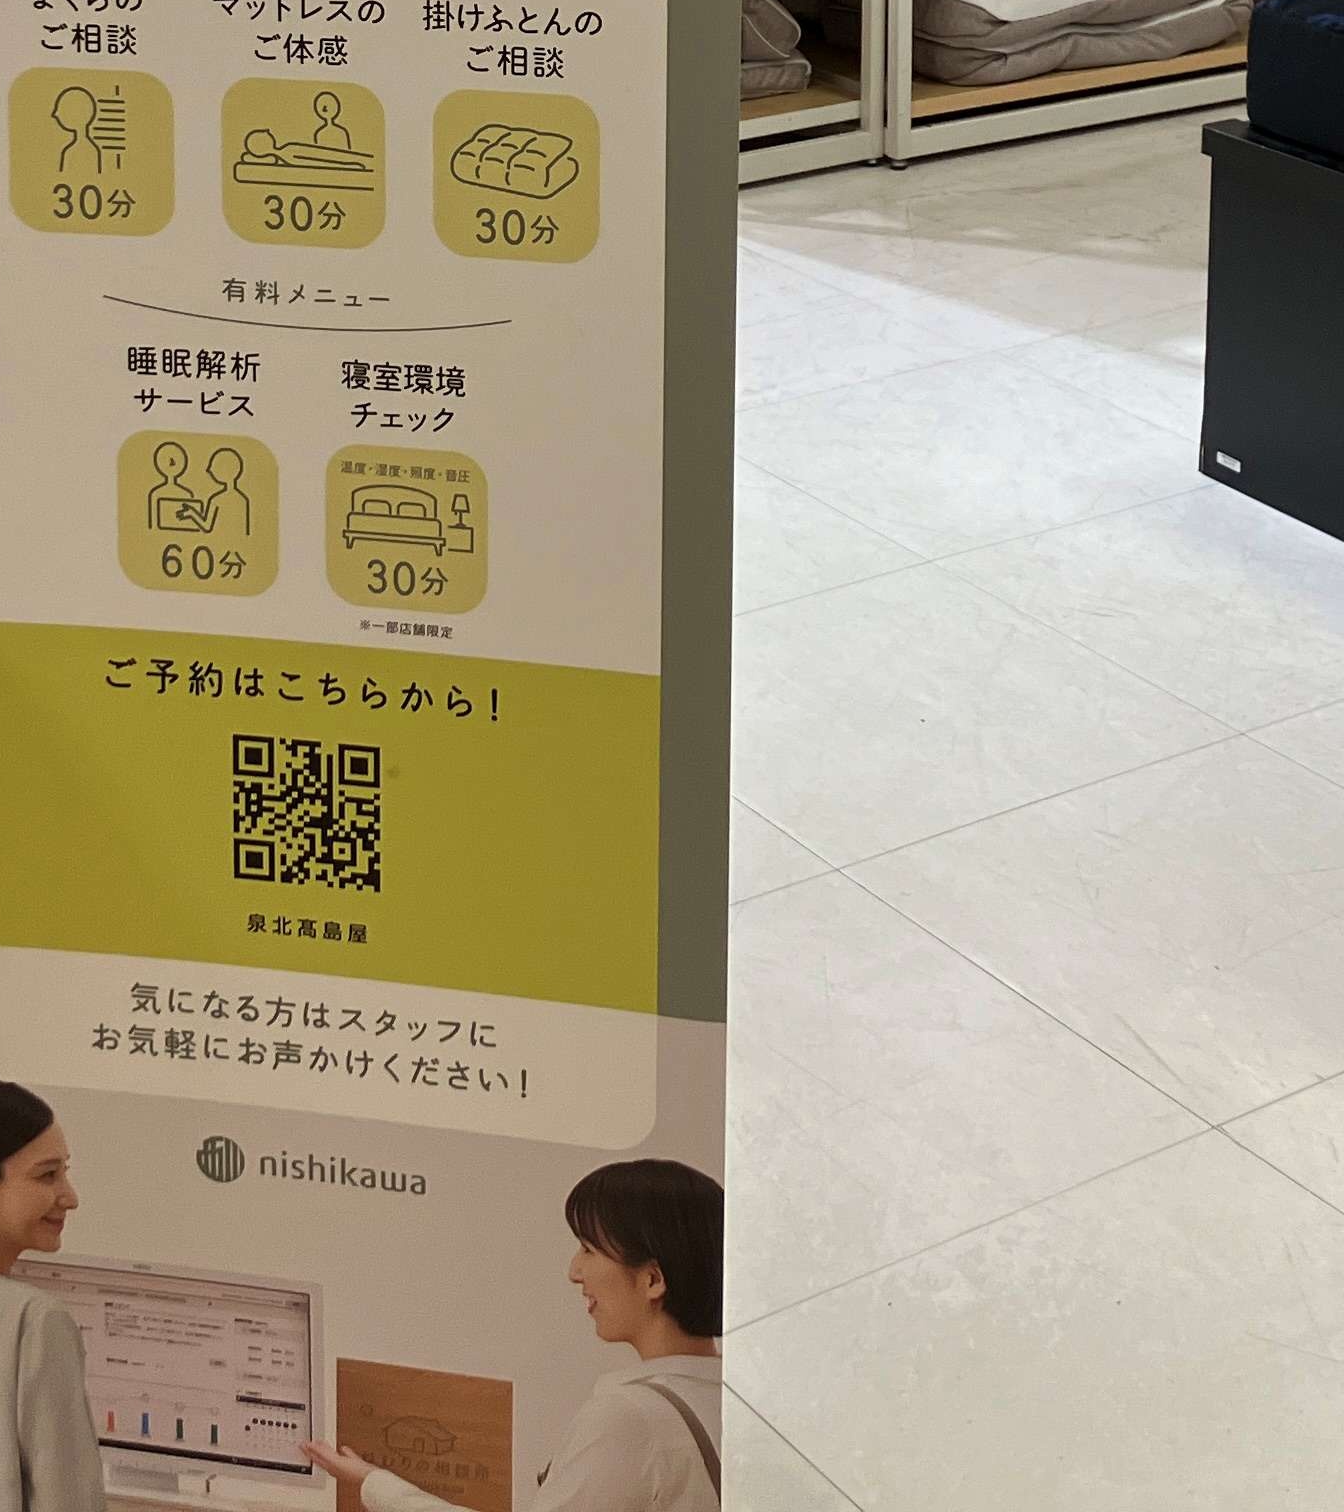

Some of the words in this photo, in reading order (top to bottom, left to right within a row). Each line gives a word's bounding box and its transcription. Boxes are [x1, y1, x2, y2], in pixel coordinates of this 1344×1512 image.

[421, 0, 604, 38] 掛けふとんの
[39, 22, 138, 57] ご相談
[254, 33, 349, 67] ご体感
[464, 45, 566, 80] ご相談
[51, 183, 137, 221] 30分
[262, 195, 347, 233] 30分
[474, 207, 560, 247] 30分
[221, 278, 391, 308] 有料メニュー
[126, 345, 262, 382] 睡眠解析
[340, 360, 467, 398] 寝室環境
[133, 389, 255, 417] サービス
[350, 402, 456, 434] チェック
[160, 544, 248, 581] 60分
[367, 559, 449, 597] 30分
[104, 656, 502, 723] ご予約はこちらから！
[130, 981, 498, 1048] 気になる方はスタッフに
[90, 1021, 530, 1099] お気軽にお声かけください！
[259, 1150, 427, 1196] nishikawa
